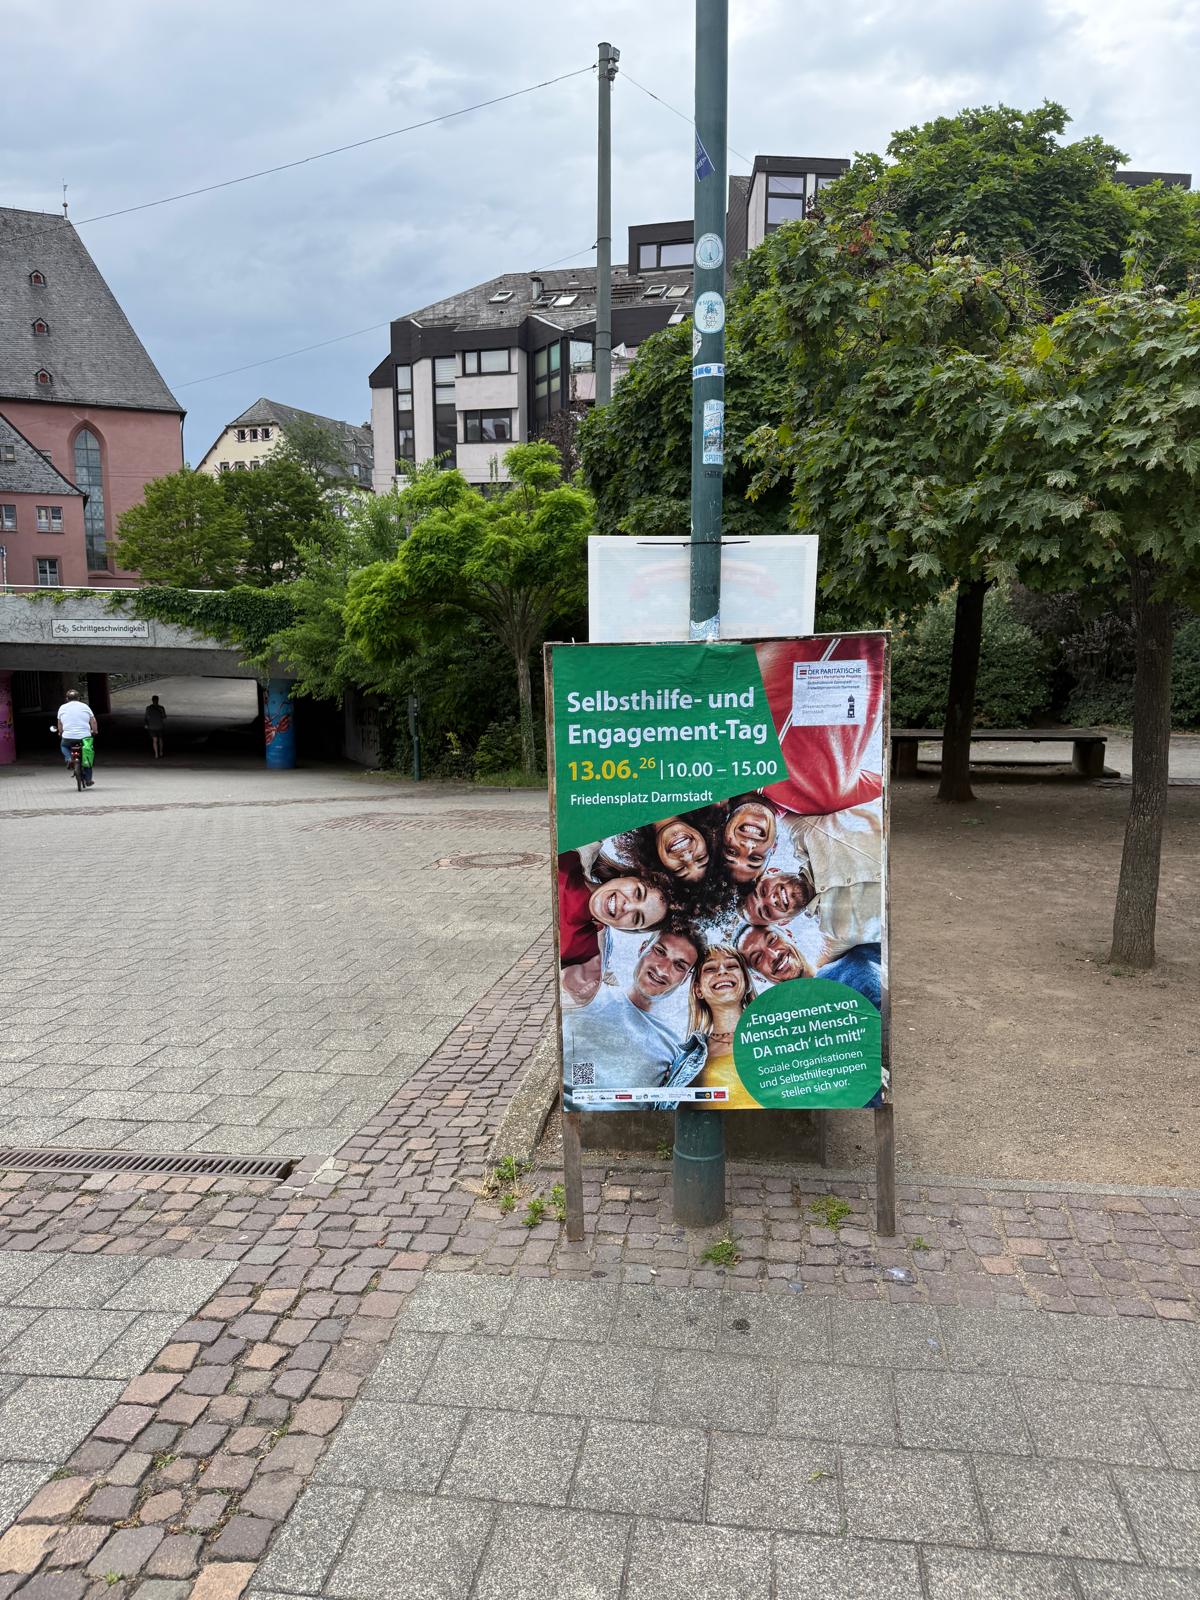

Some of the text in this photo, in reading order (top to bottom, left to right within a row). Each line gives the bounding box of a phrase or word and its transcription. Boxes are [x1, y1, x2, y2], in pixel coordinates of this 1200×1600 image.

[71, 624, 146, 633] Schrittgeschwindigkeit
[567, 687, 755, 713] Selbsthilfe- und
[568, 720, 768, 749] Engagement-Tag
[569, 759, 638, 781] 13.06.
[640, 757, 656, 769] 26
[731, 760, 778, 776] 15.00
[570, 790, 713, 807] Friedensplatz Darmstadt
[746, 999, 858, 1028] „Engagement von
[740, 1026, 789, 1045] Mensch
[792, 1024, 806, 1035] zu
[809, 1013, 858, 1028] Mensch
[753, 1045, 772, 1059] DA
[815, 1034, 833, 1048] ich
[758, 1049, 863, 1076] Soziale Organisationen
[759, 1062, 867, 1089] und Selbsthilfegruppen
[781, 1078, 850, 1099] stellen sich vor.
